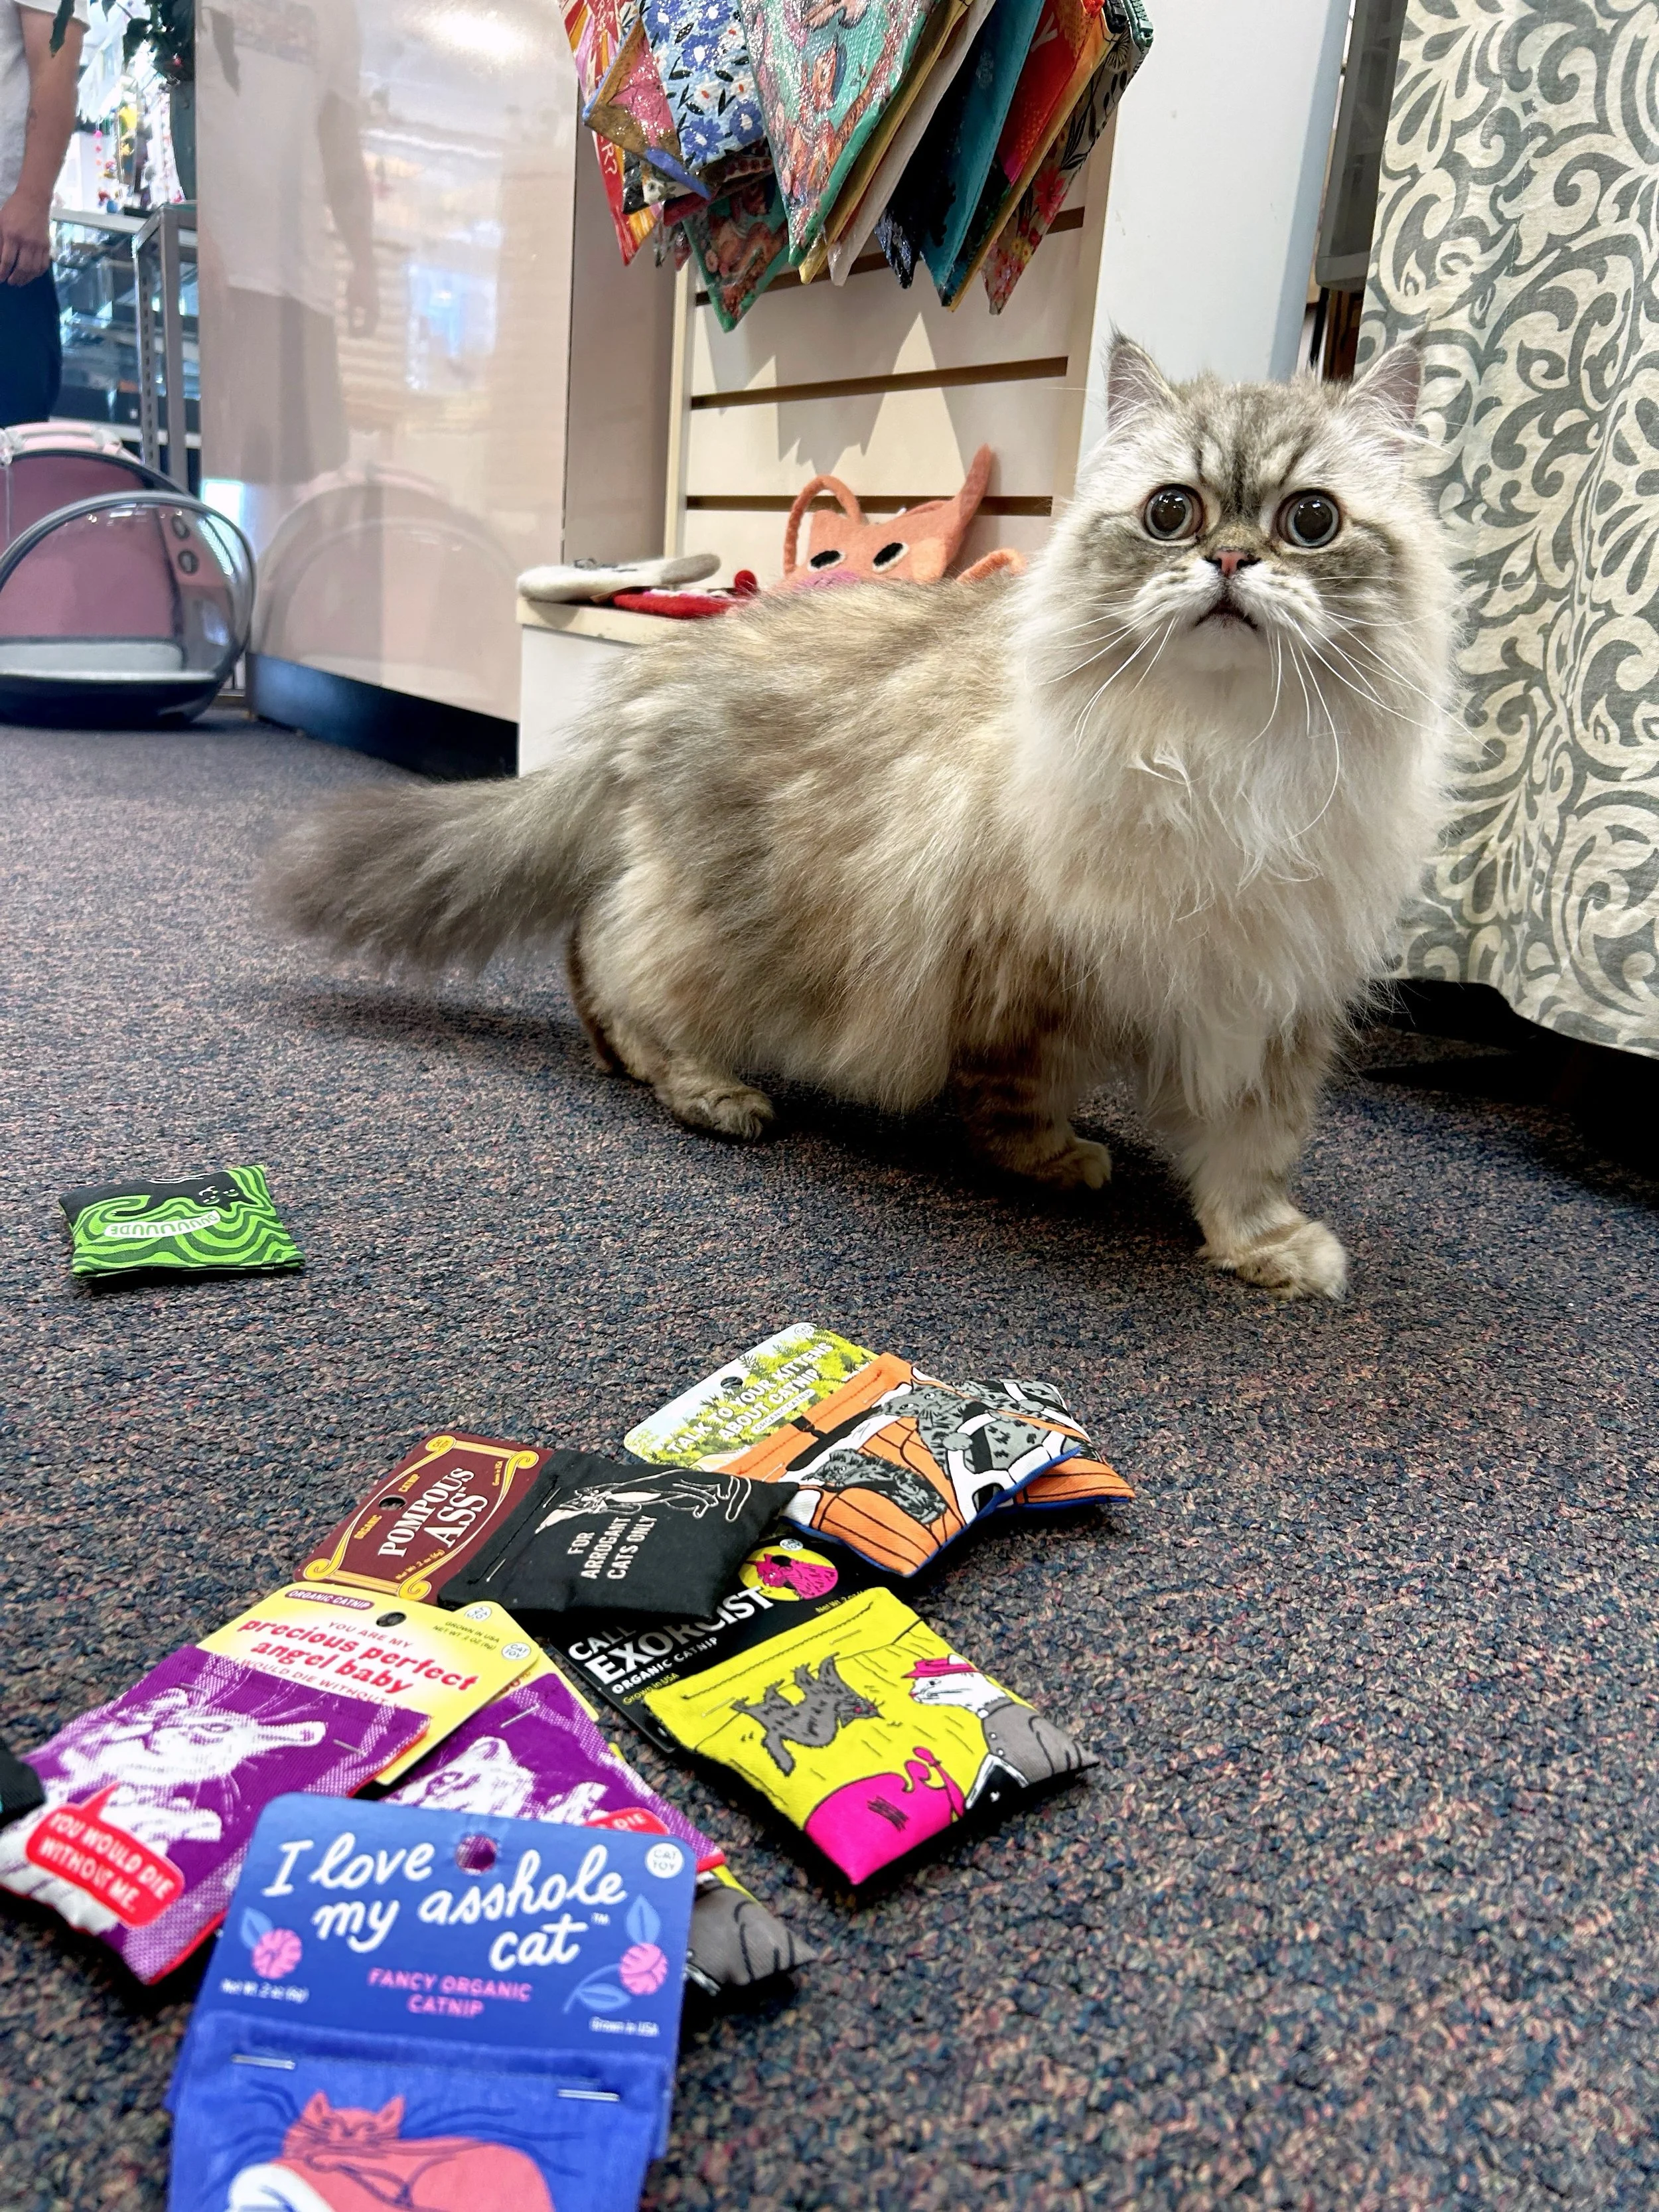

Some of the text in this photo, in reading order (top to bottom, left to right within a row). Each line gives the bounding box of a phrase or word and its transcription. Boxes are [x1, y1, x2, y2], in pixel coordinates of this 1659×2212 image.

[666, 1422, 713, 1453] TALK
[707, 1407, 734, 1424] TO
[730, 1379, 776, 1408] YOUR
[772, 1342, 833, 1381] KITTENS
[719, 1401, 770, 1441] ABOUT
[768, 1368, 819, 1404] CATNIP
[755, 1390, 811, 1431] ORGANIC CATNIP
[378, 1467, 474, 1558] POMPOUS
[424, 1494, 488, 1548] ASS
[567, 1530, 596, 1555] FOR
[580, 1516, 632, 1580] ARROGANT
[607, 1515, 658, 1580] CATS ONLY
[289, 1590, 370, 1609] ORGANIC CATNIP
[237, 1617, 480, 1691] precious perfect
[328, 1621, 414, 1649] YOU ARE MY
[504, 1648, 523, 1658] TOY
[510, 1644, 530, 1653] CAT
[568, 1625, 636, 1662] CALL
[241, 1659, 290, 1675] WOULD
[291, 1670, 318, 1683] DIE
[250, 1642, 414, 1694] angel baby
[612, 1637, 717, 1694] ORGANIC CATNIP
[622, 1684, 654, 1706] Grown
[660, 1672, 680, 1686] USA
[39, 1838, 140, 1913] WITHOUT ME
[48, 1812, 175, 1901] YOU WOULD DIE
[261, 1832, 436, 1897] I love
[653, 1849, 678, 1860] CAT
[311, 1844, 628, 1953] my asshole
[488, 1913, 590, 1972] cat
[367, 1967, 533, 2003] FANCY ORGANIC
[407, 1993, 485, 2018] CATNIP
